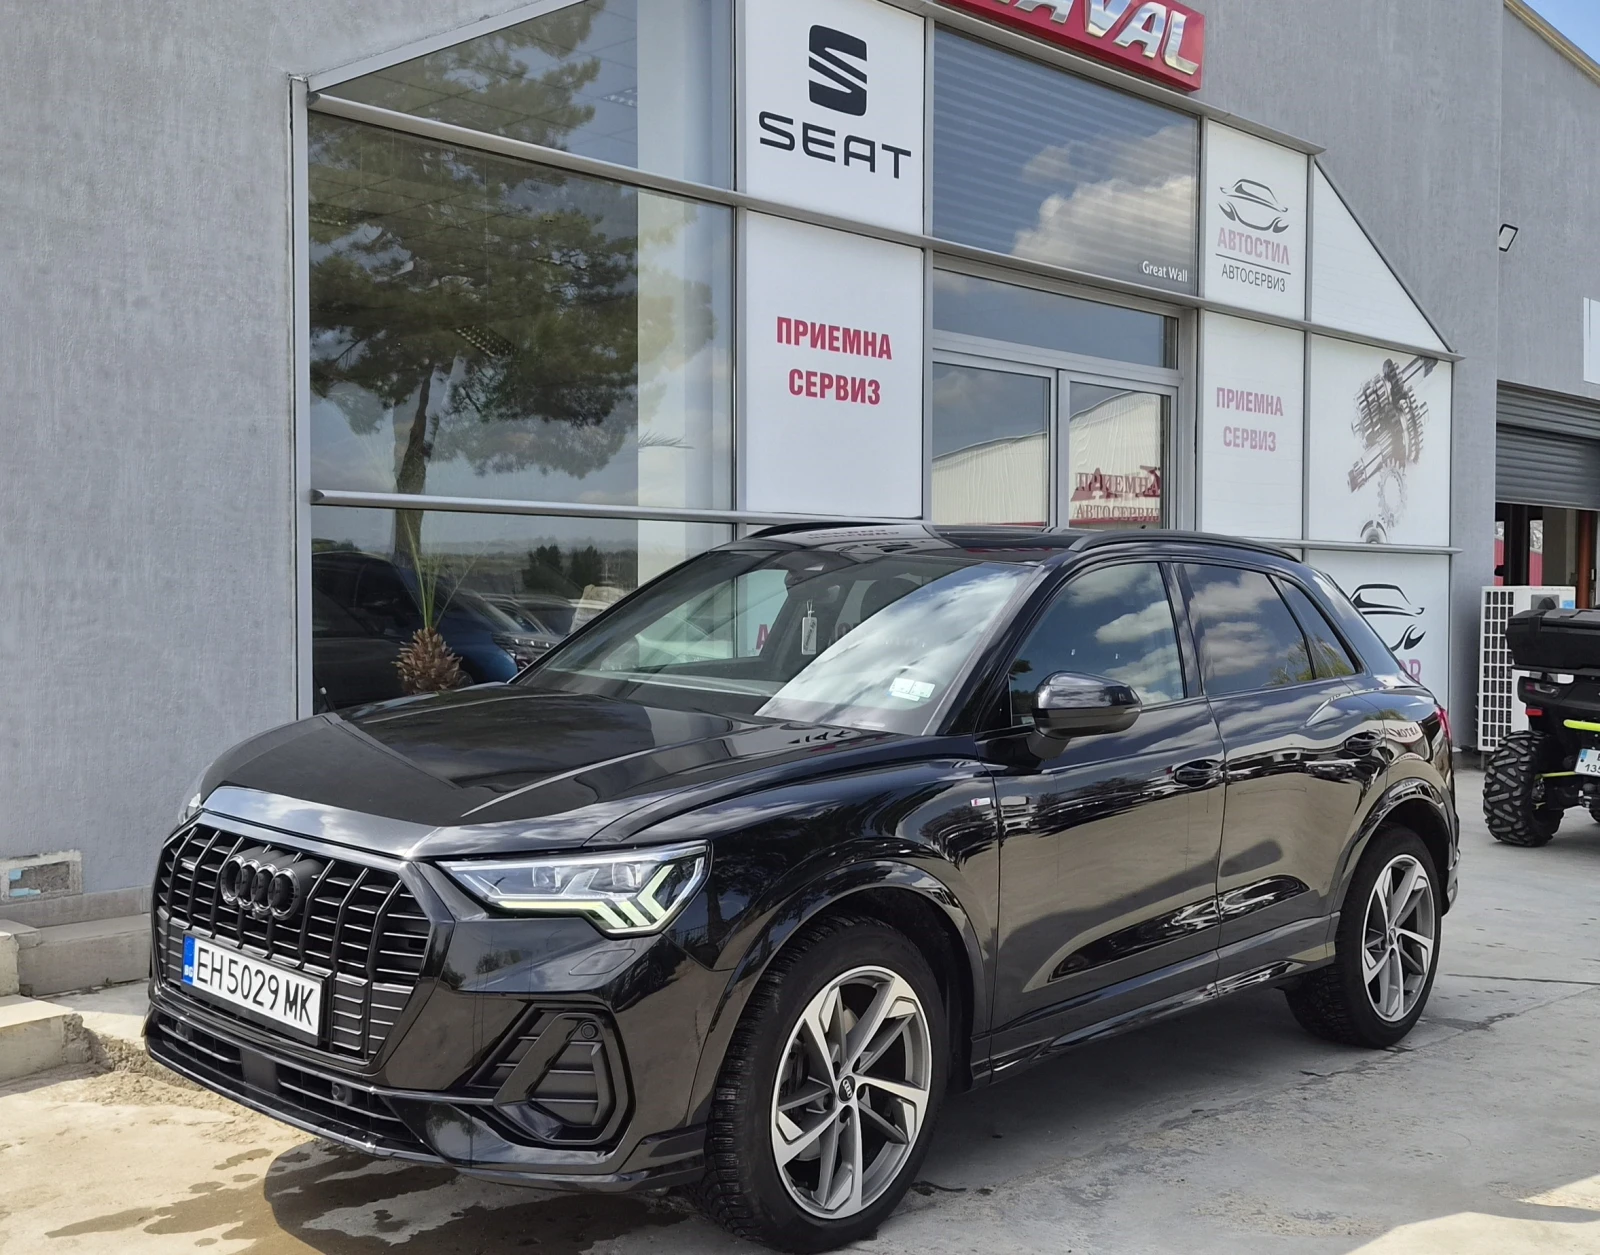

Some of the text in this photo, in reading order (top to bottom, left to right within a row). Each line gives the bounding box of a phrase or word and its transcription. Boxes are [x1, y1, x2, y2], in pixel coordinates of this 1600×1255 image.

[993, 0, 1199, 75] VAL
[758, 111, 912, 179] SEAT
[1217, 227, 1290, 265] АВТОСТИЛ
[1142, 260, 1188, 282] Great Wall
[1221, 263, 1286, 293] АВТОСЕРВИЗ
[777, 316, 892, 360] ПРИЕМНА
[788, 369, 881, 405] СЕРВИЗ
[1216, 387, 1283, 416] ПРИЕМНА
[1223, 426, 1276, 452] СЕРВИЗ
